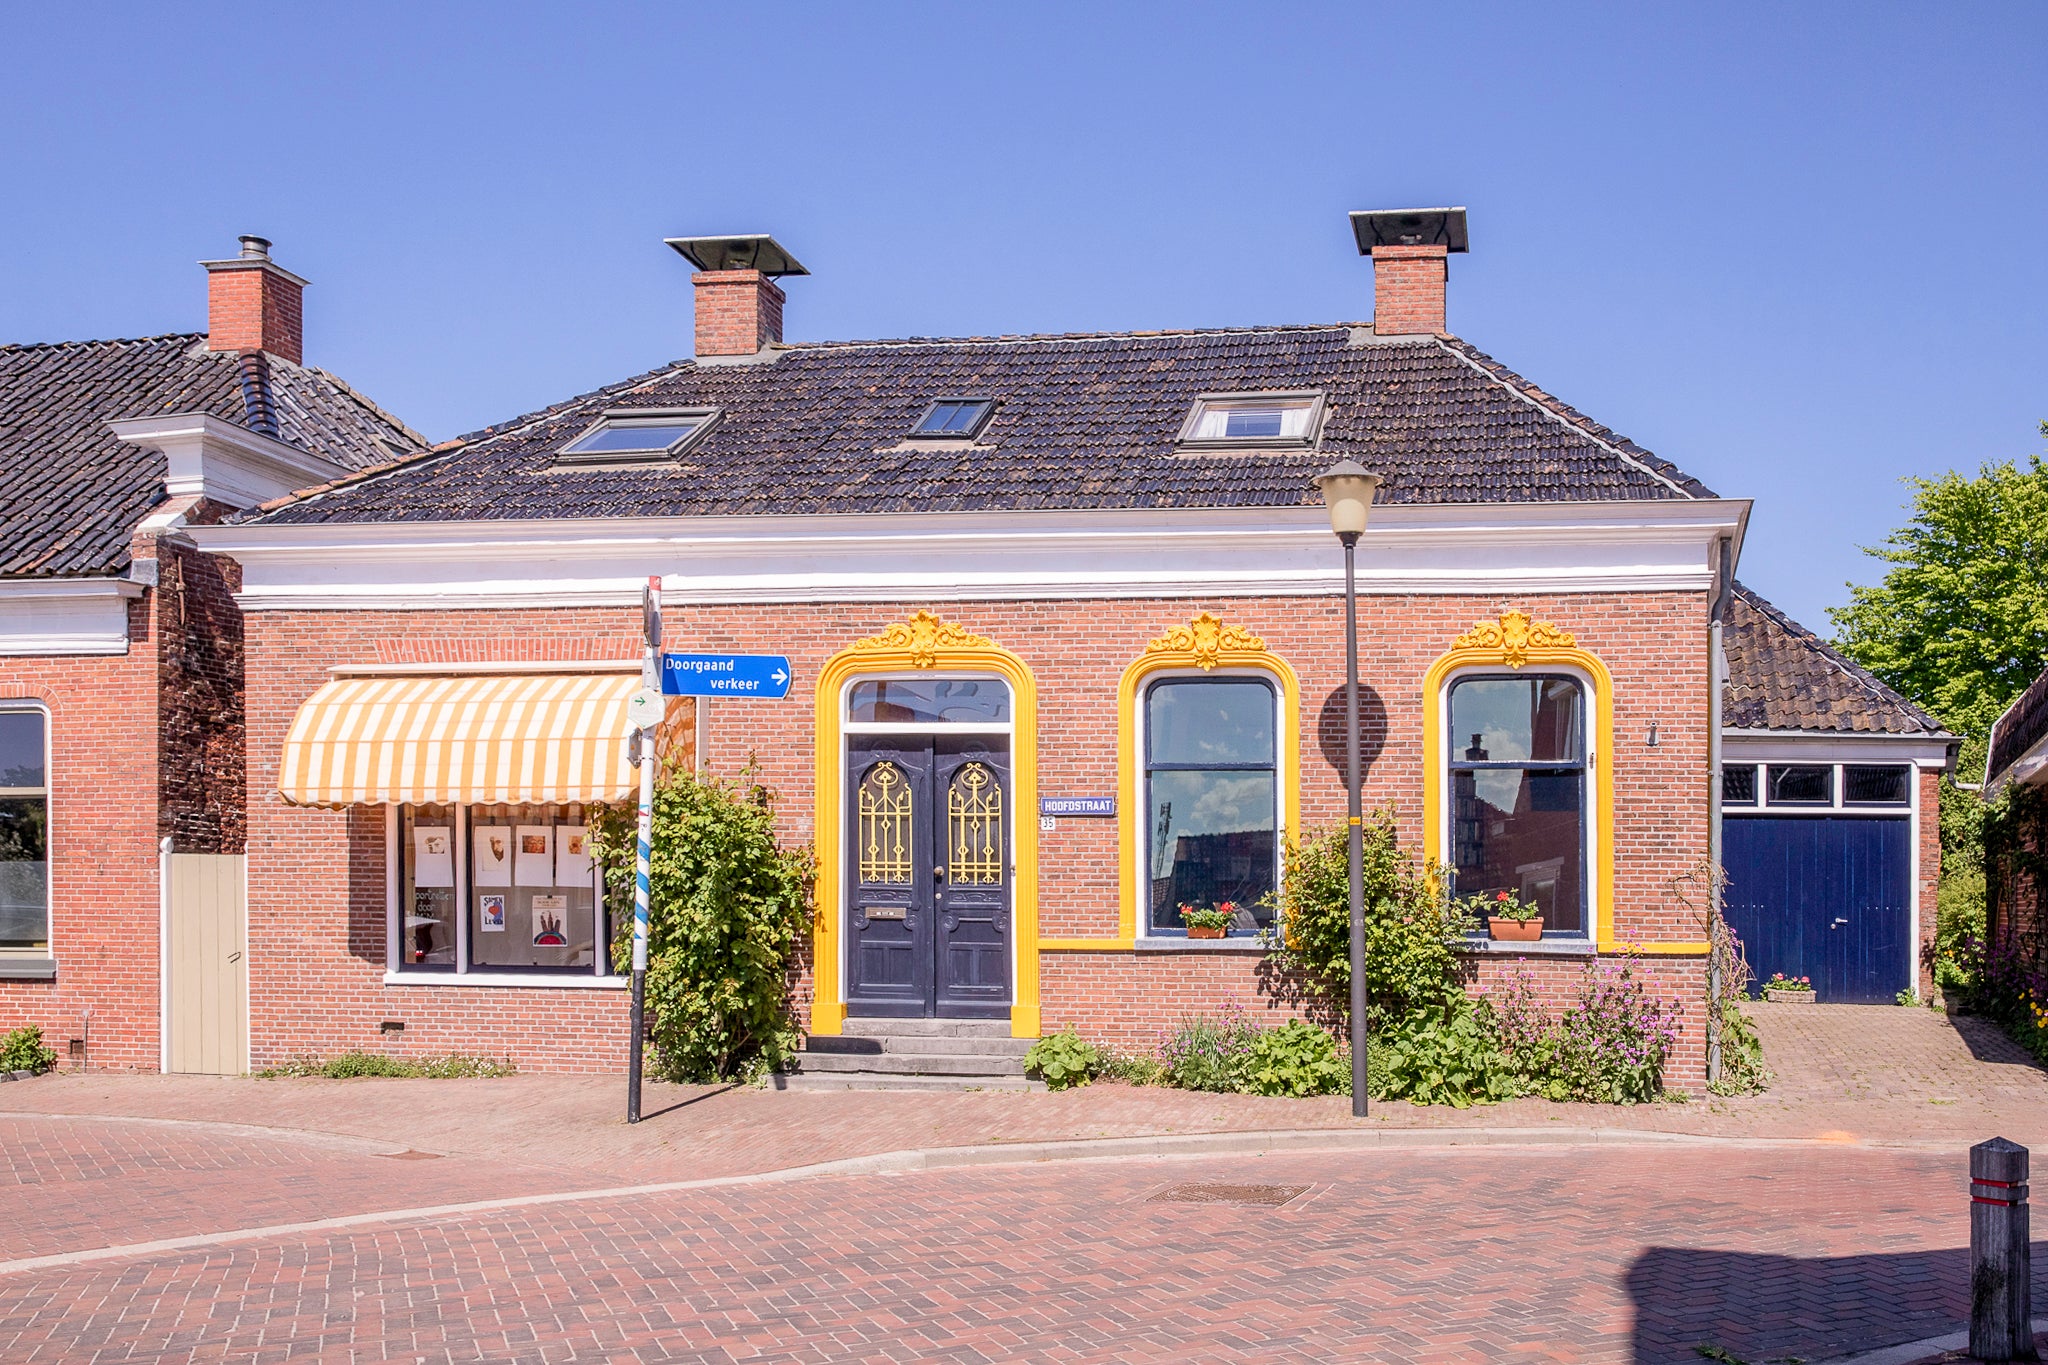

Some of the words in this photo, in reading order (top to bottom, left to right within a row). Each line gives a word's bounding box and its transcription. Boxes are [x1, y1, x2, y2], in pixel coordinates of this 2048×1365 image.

[666, 658, 734, 673] Doorgaand
[710, 678, 760, 690] verkeer
[1045, 801, 1111, 811] HOOFDSTRAAT
[1043, 818, 1053, 828] 35
[417, 901, 436, 912] door
